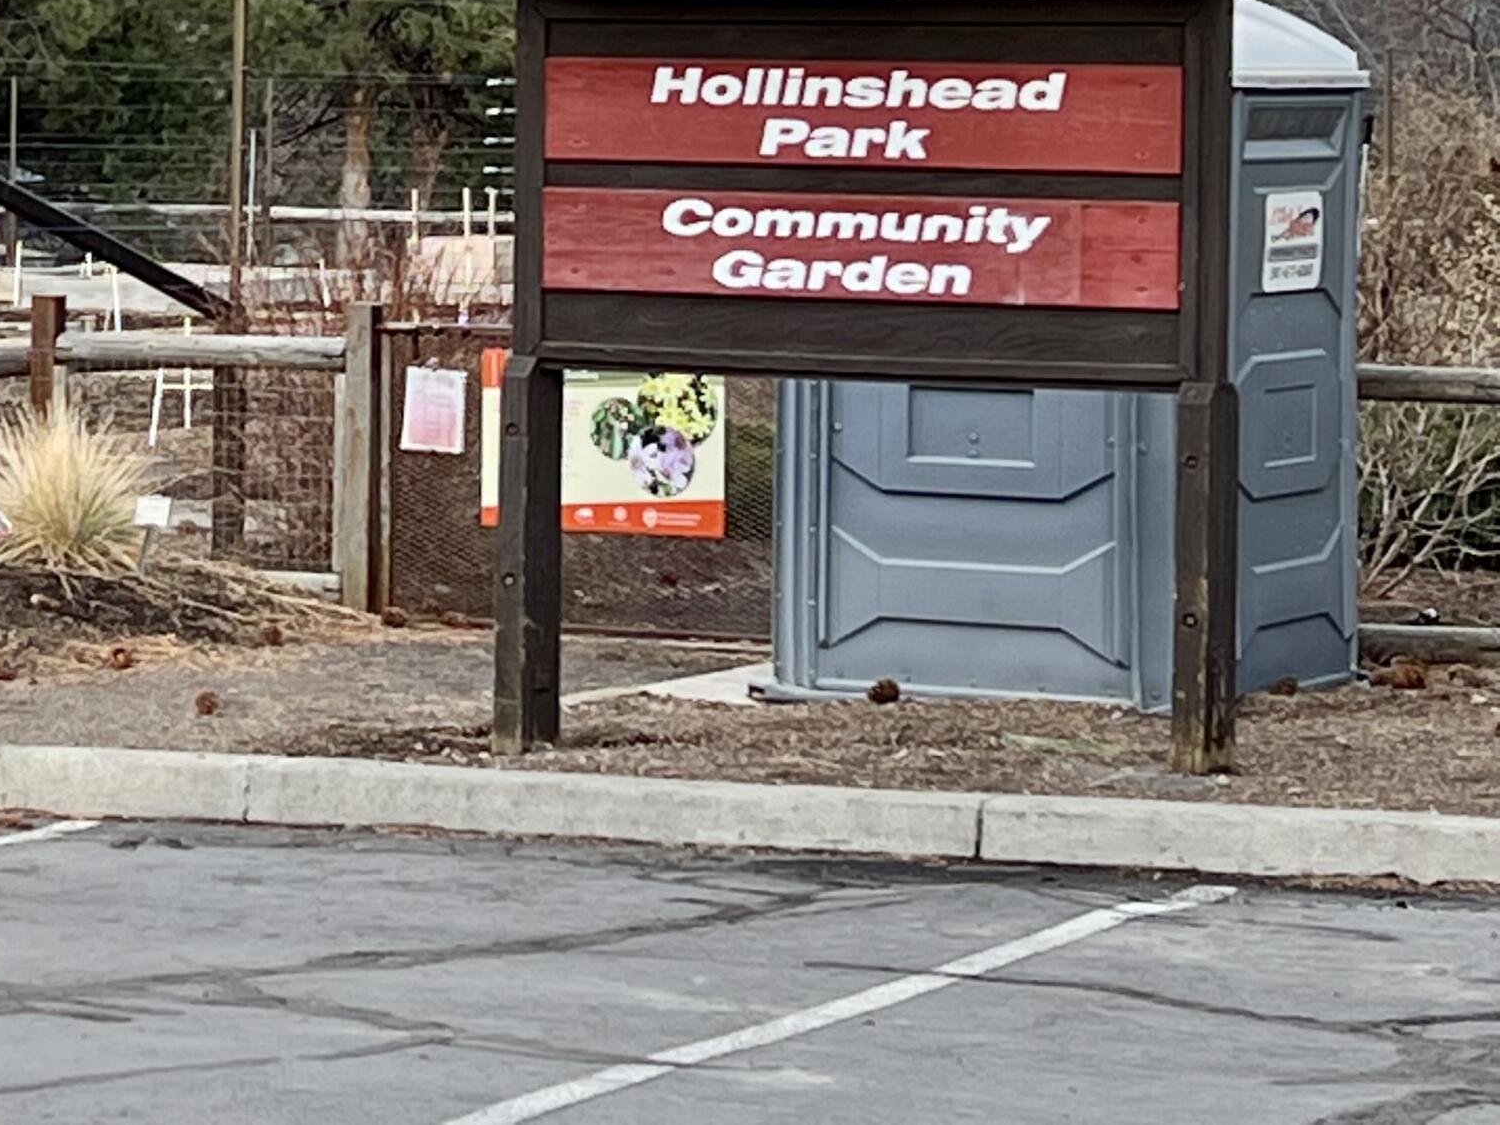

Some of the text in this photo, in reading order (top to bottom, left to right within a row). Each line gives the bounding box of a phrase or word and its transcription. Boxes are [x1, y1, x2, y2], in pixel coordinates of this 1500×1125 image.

[650, 66, 1067, 111] Hollinshead
[759, 118, 930, 159] Park
[662, 198, 1051, 254] Community
[712, 249, 972, 295] Garden
